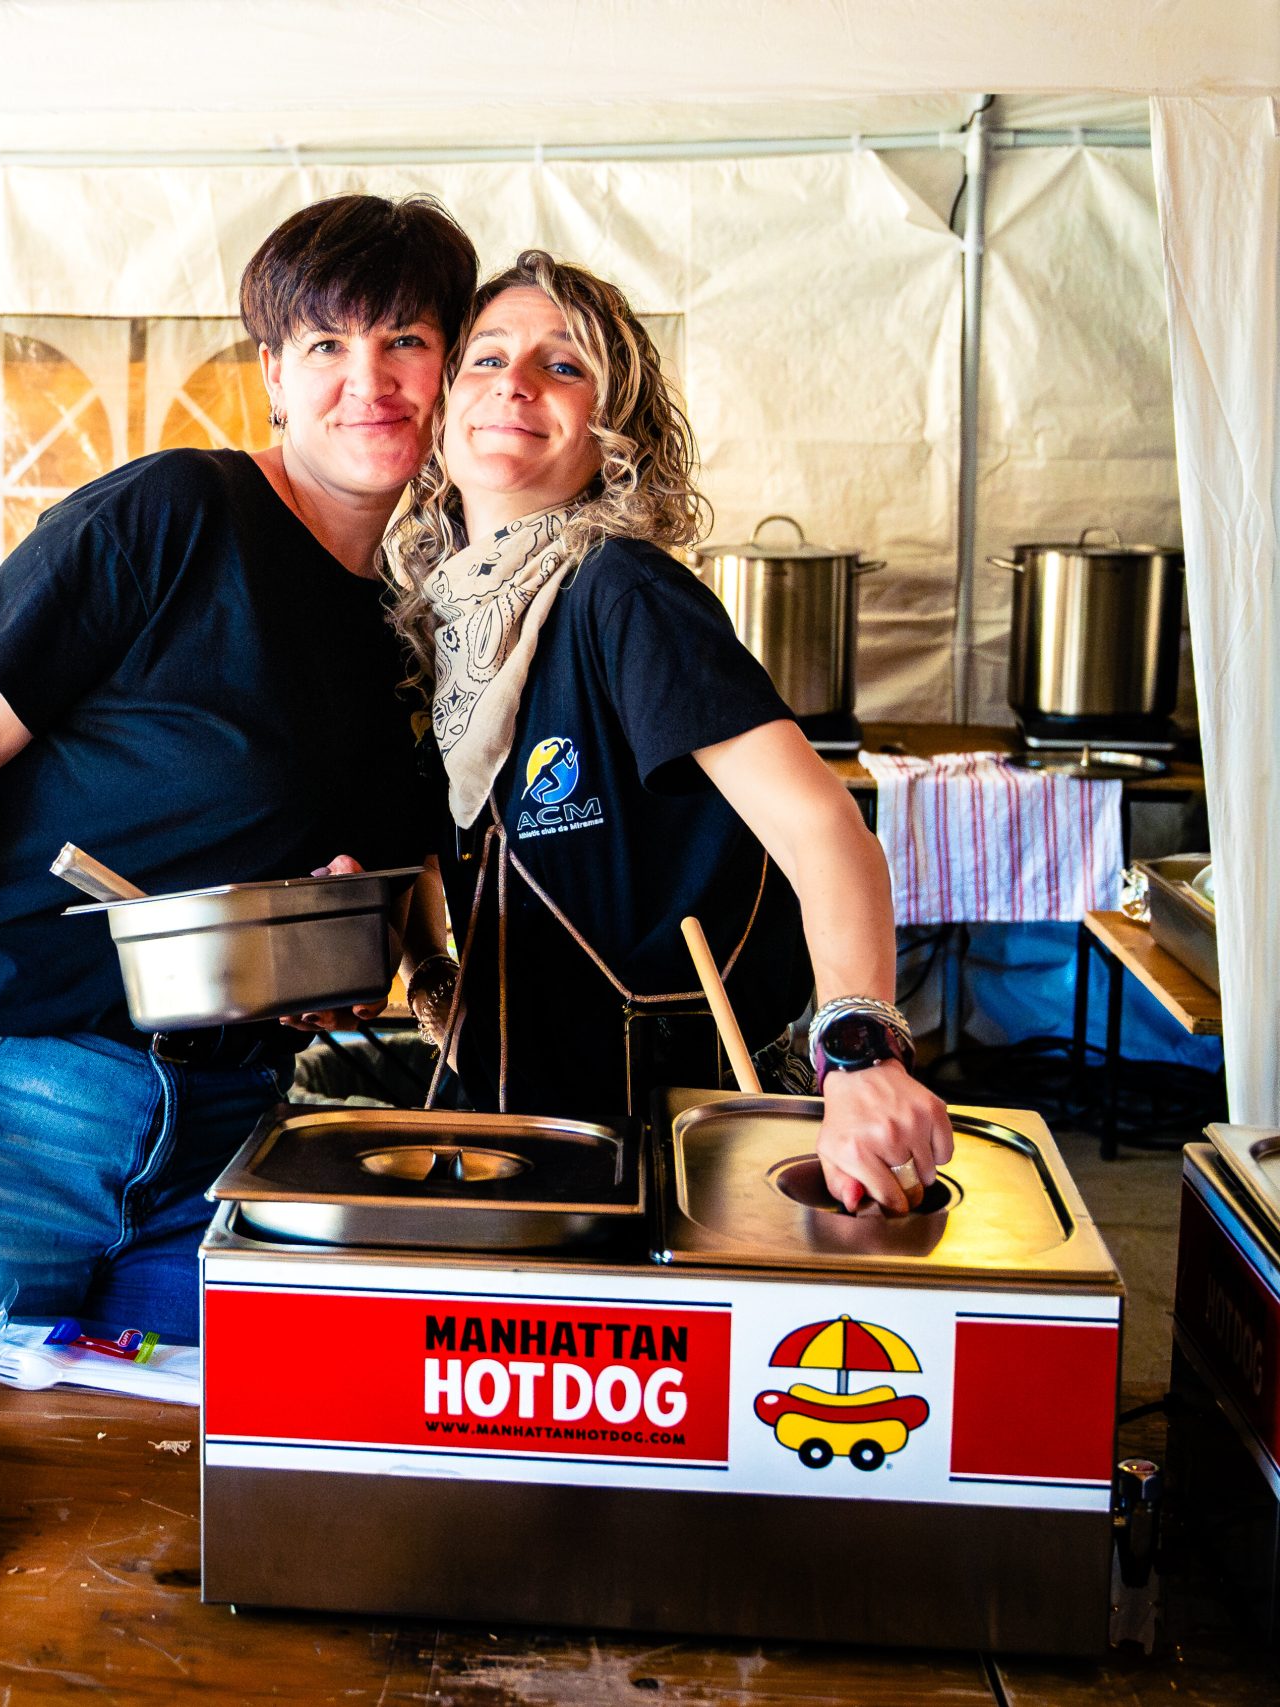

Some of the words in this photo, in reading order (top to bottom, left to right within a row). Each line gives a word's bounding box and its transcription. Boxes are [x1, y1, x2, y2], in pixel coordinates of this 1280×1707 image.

[517, 798, 601, 831] ACM
[541, 826, 557, 836] club
[425, 1315, 688, 1362] MANHATTAN
[1232, 1308, 1265, 1397] DOG
[424, 1358, 545, 1418] HOT
[552, 1362, 688, 1428] DOG
[425, 1421, 686, 1445] WWW.MANHATTANHOTDOG.COM
